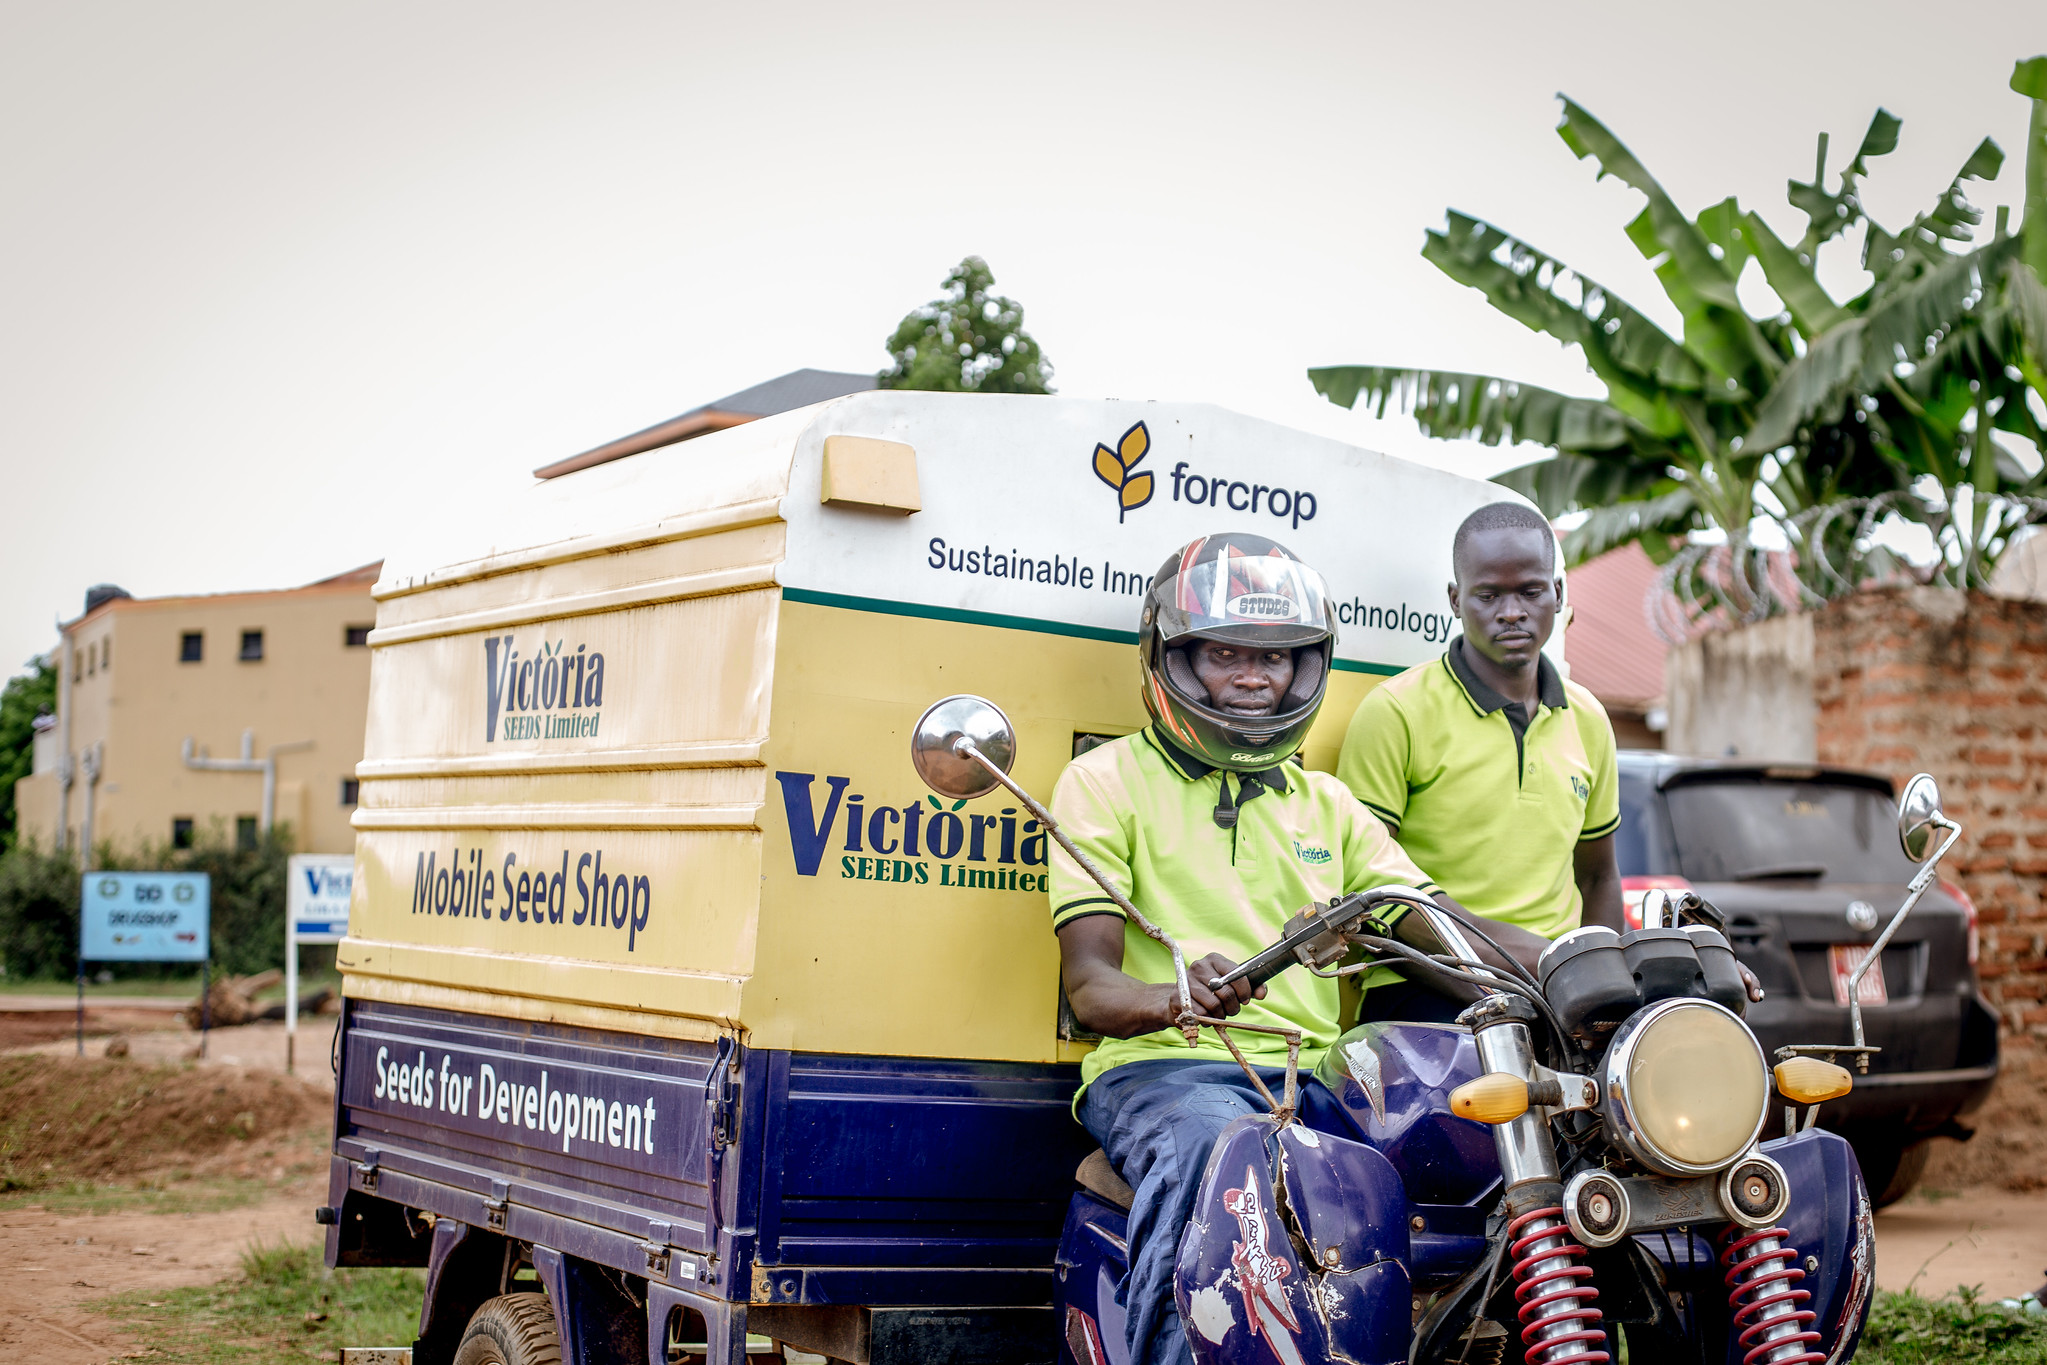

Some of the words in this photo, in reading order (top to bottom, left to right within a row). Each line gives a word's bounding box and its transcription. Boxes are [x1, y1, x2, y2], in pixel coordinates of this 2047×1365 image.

[1170, 461, 1318, 530] forcrop
[928, 536, 1094, 589] Sustainable
[1239, 597, 1291, 616] STUDDS
[1333, 596, 1453, 643] chnology
[485, 634, 605, 742] Victoria
[504, 714, 542, 741] SEEDS
[544, 711, 601, 739] Limited
[775, 770, 1049, 877] Victoria
[1293, 840, 1331, 860] Victoria
[841, 855, 930, 885] SEEDS
[412, 848, 495, 920] Mobile
[499, 849, 570, 924] Seed
[572, 849, 651, 952] Shop
[374, 1046, 435, 1110] Seeds
[439, 1054, 472, 1116] for
[478, 1063, 656, 1155] Development
